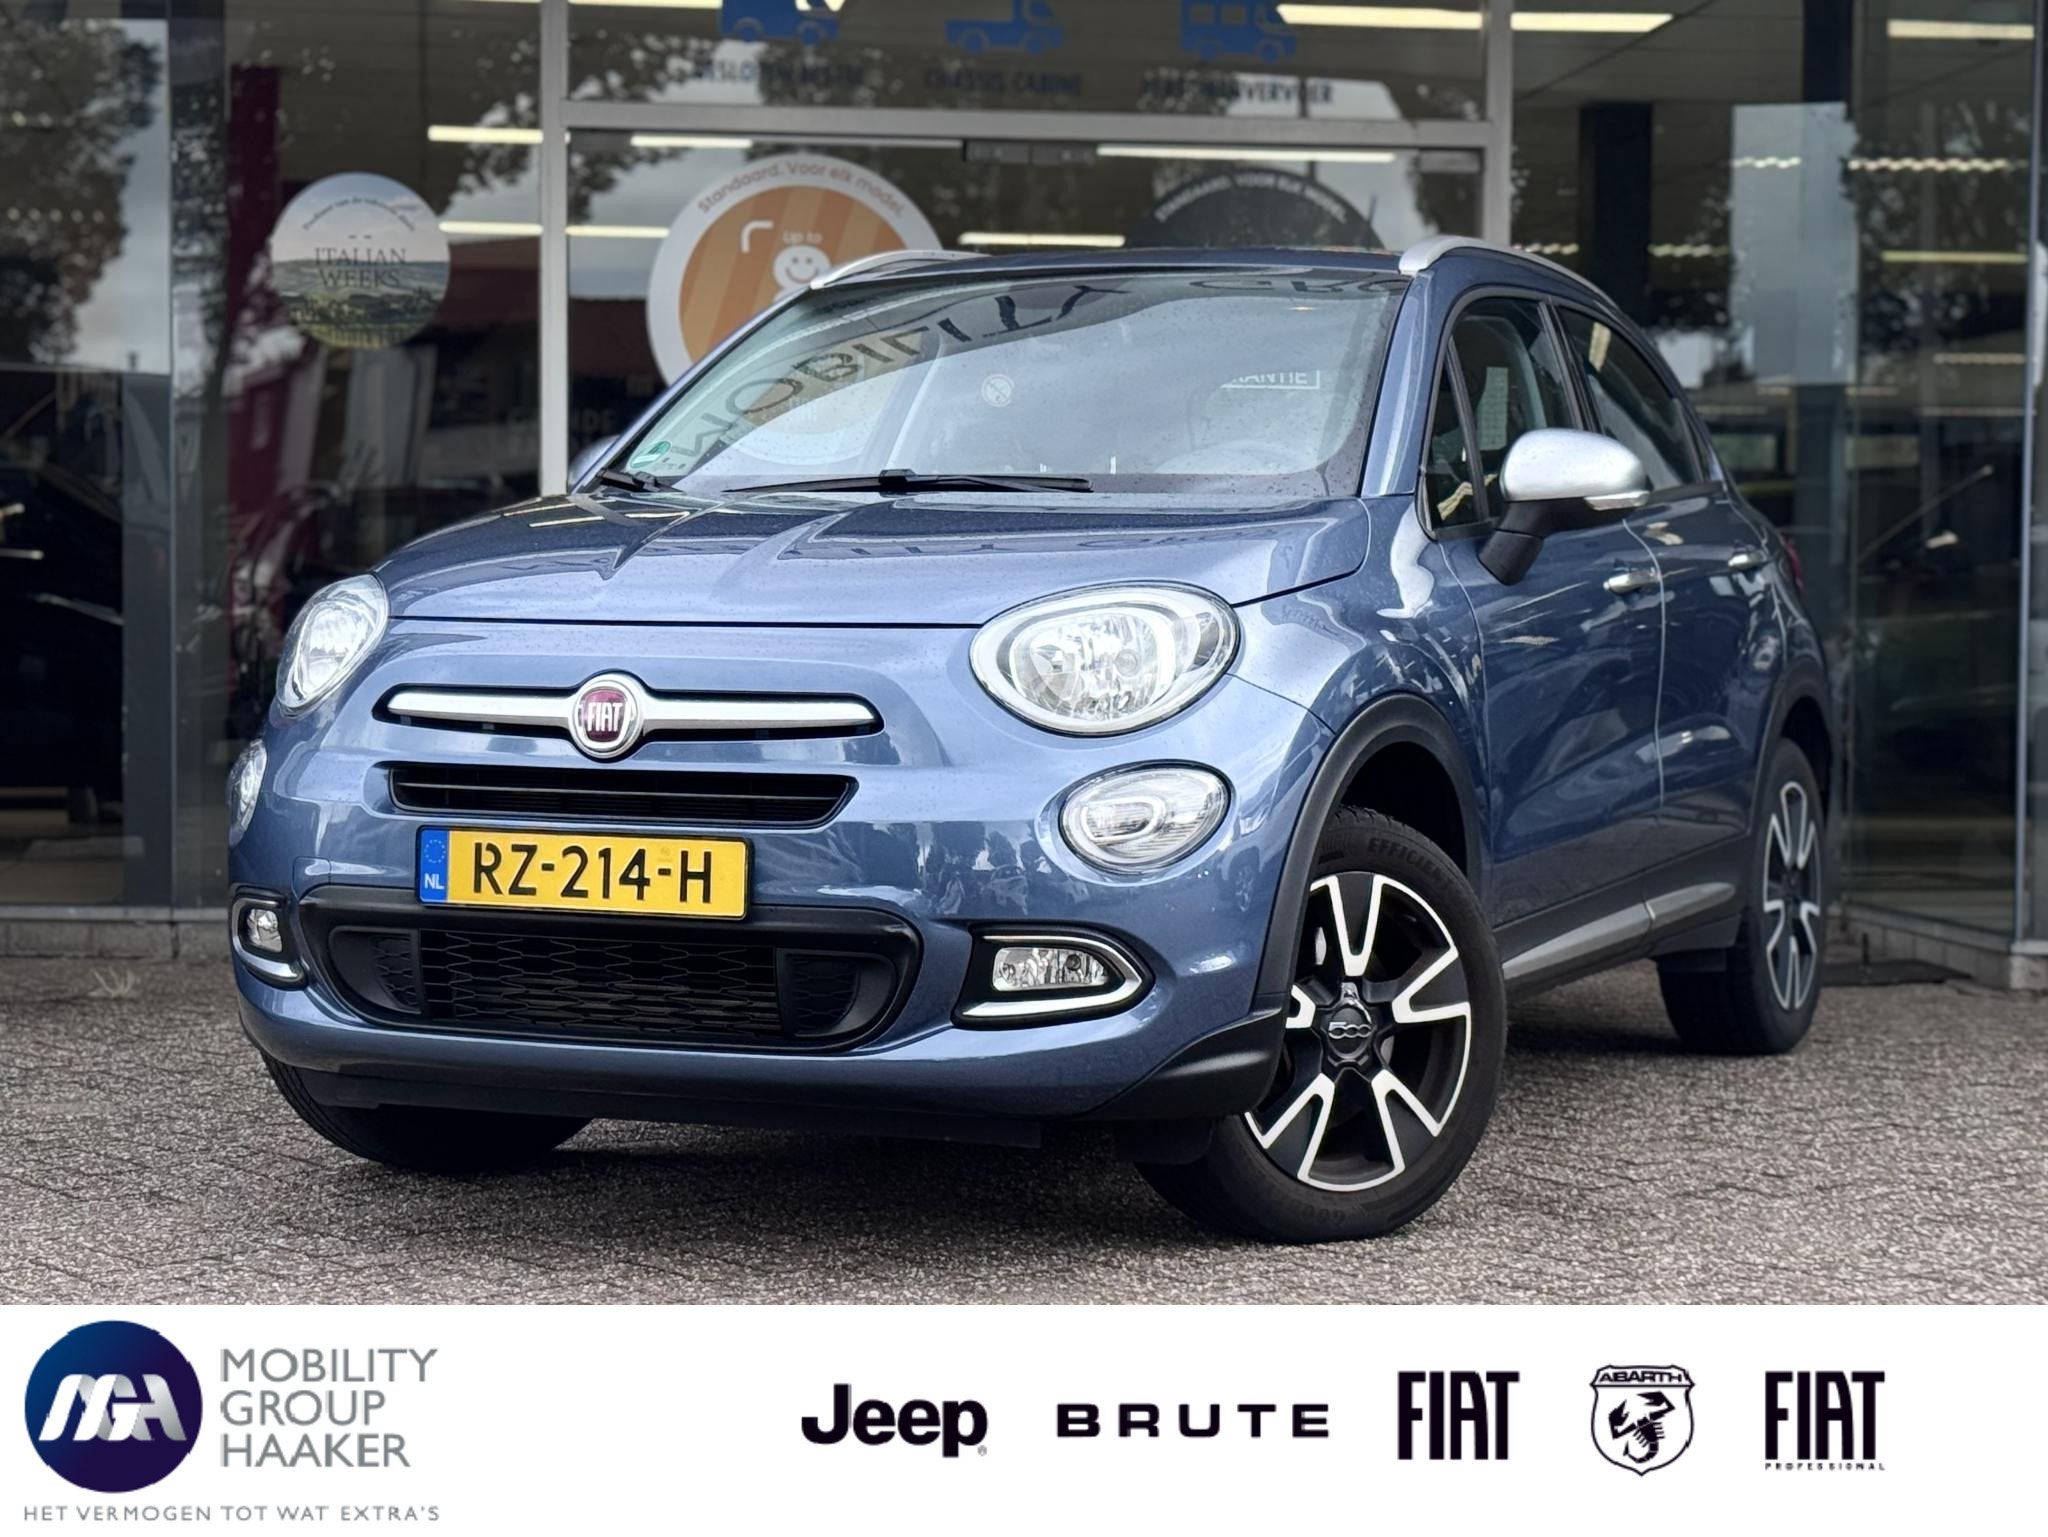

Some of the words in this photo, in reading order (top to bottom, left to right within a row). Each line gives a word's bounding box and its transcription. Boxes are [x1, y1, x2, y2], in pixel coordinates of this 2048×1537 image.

[786, 161, 827, 177] Voor
[807, 230, 823, 244] to
[315, 246, 407, 267] ITALIAN
[318, 267, 402, 289] WEEKS
[587, 702, 624, 732] FIAT
[424, 871, 445, 891] NL
[473, 842, 712, 904] RZ-214-H
